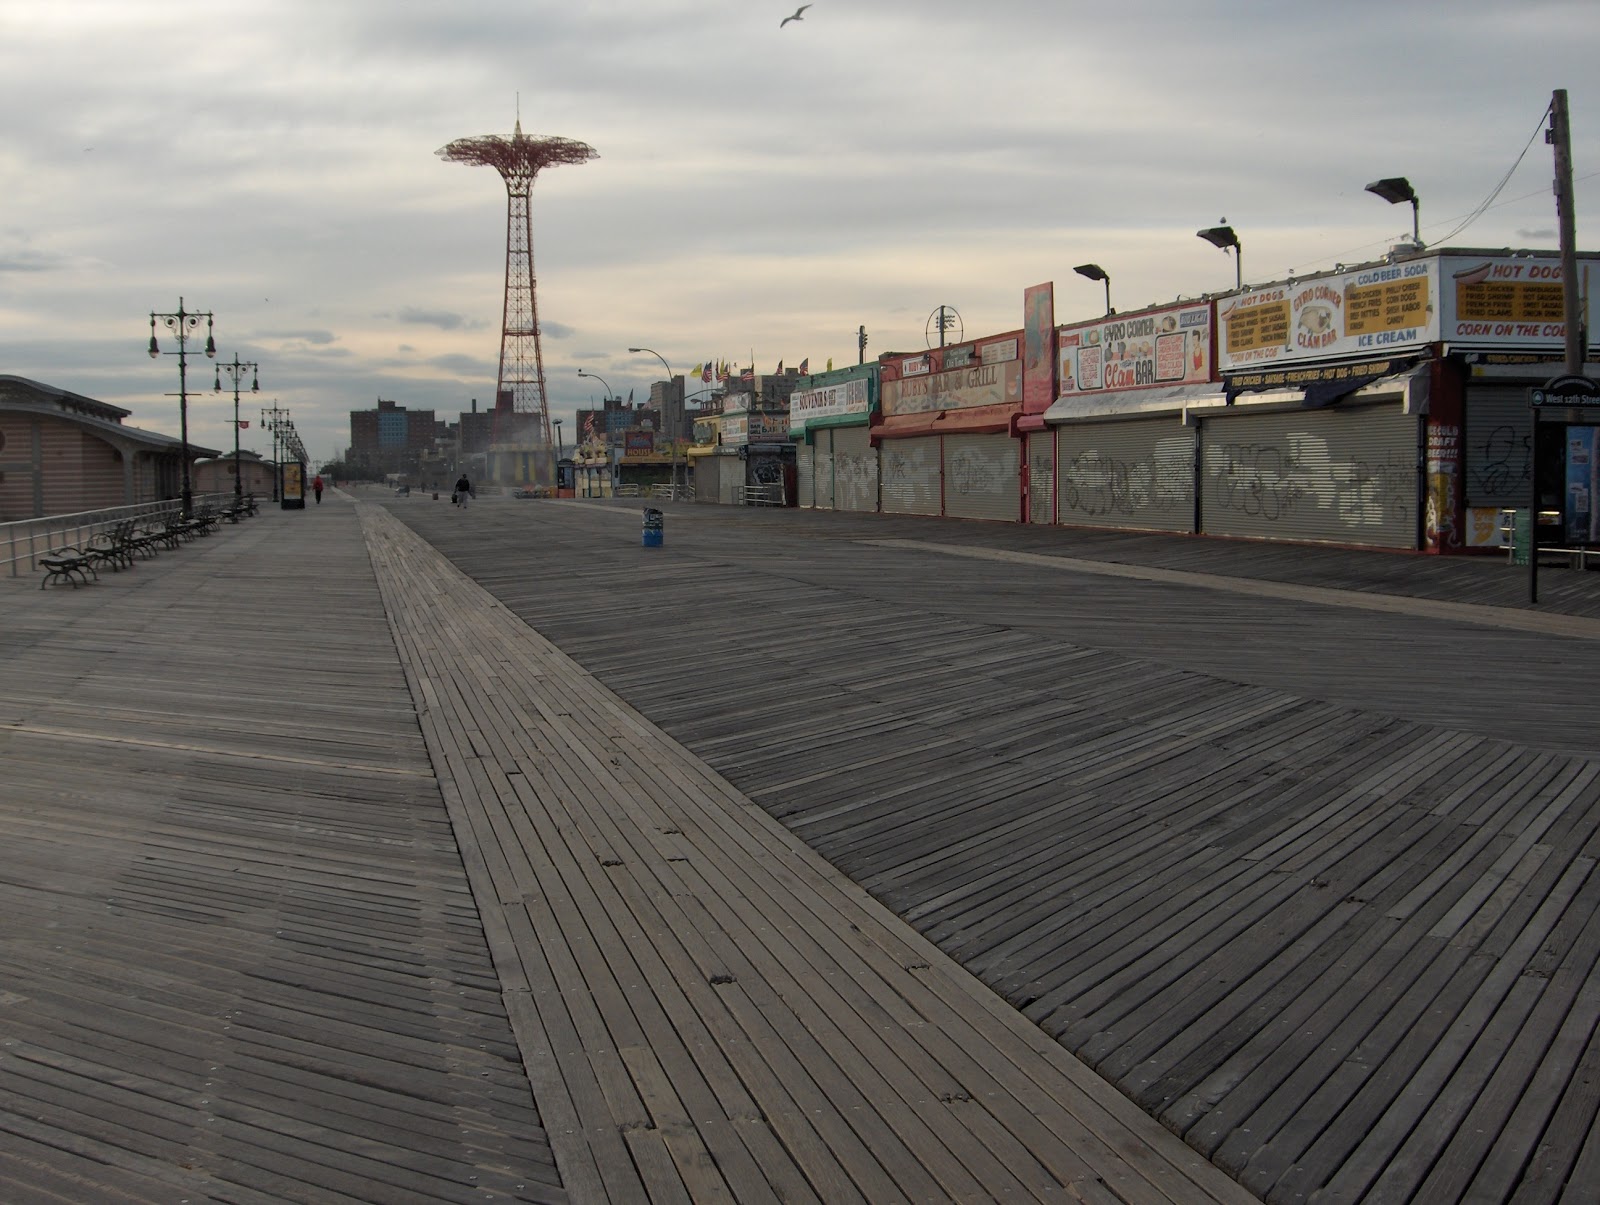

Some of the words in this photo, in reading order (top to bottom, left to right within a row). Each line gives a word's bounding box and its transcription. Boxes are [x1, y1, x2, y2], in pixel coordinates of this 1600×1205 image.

[1358, 272, 1379, 285] COLD
[1381, 269, 1402, 281] BEER
[1404, 264, 1428, 277] SODA
[1492, 265, 1524, 278] HOT
[1529, 266, 1564, 279] DOG
[1241, 296, 1258, 306] HOT
[1260, 290, 1284, 302] DOGS
[1315, 286, 1341, 309] CORNER
[1400, 292, 1416, 302] DOGS
[1104, 321, 1126, 342] GYRO
[1126, 318, 1154, 338] CORNER
[1456, 322, 1492, 336] CORN
[1494, 324, 1514, 336] ON
[1516, 325, 1540, 337] THE
[1298, 332, 1320, 349] CLAM
[1322, 328, 1337, 347] BAR
[1358, 334, 1373, 347] ICE
[1376, 329, 1416, 345] CREAM
[1104, 362, 1135, 388] Clam
[1136, 360, 1154, 385] BAR
[1324, 368, 1336, 378] HOT
[1336, 367, 1348, 378] DOG
[1352, 365, 1367, 376] FRIED
[1368, 362, 1390, 374] SHRIMP
[902, 377, 928, 398] RUBY'S
[932, 374, 950, 394] BAR
[955, 372, 964, 390] &
[968, 366, 998, 388] GRILL
[1546, 394, 1564, 404] West
[1564, 394, 1580, 404] 12th
[1582, 394, 1600, 404] Stree
[1428, 437, 1456, 446] DRAFT
[1428, 449, 1458, 458] BEER!!!
